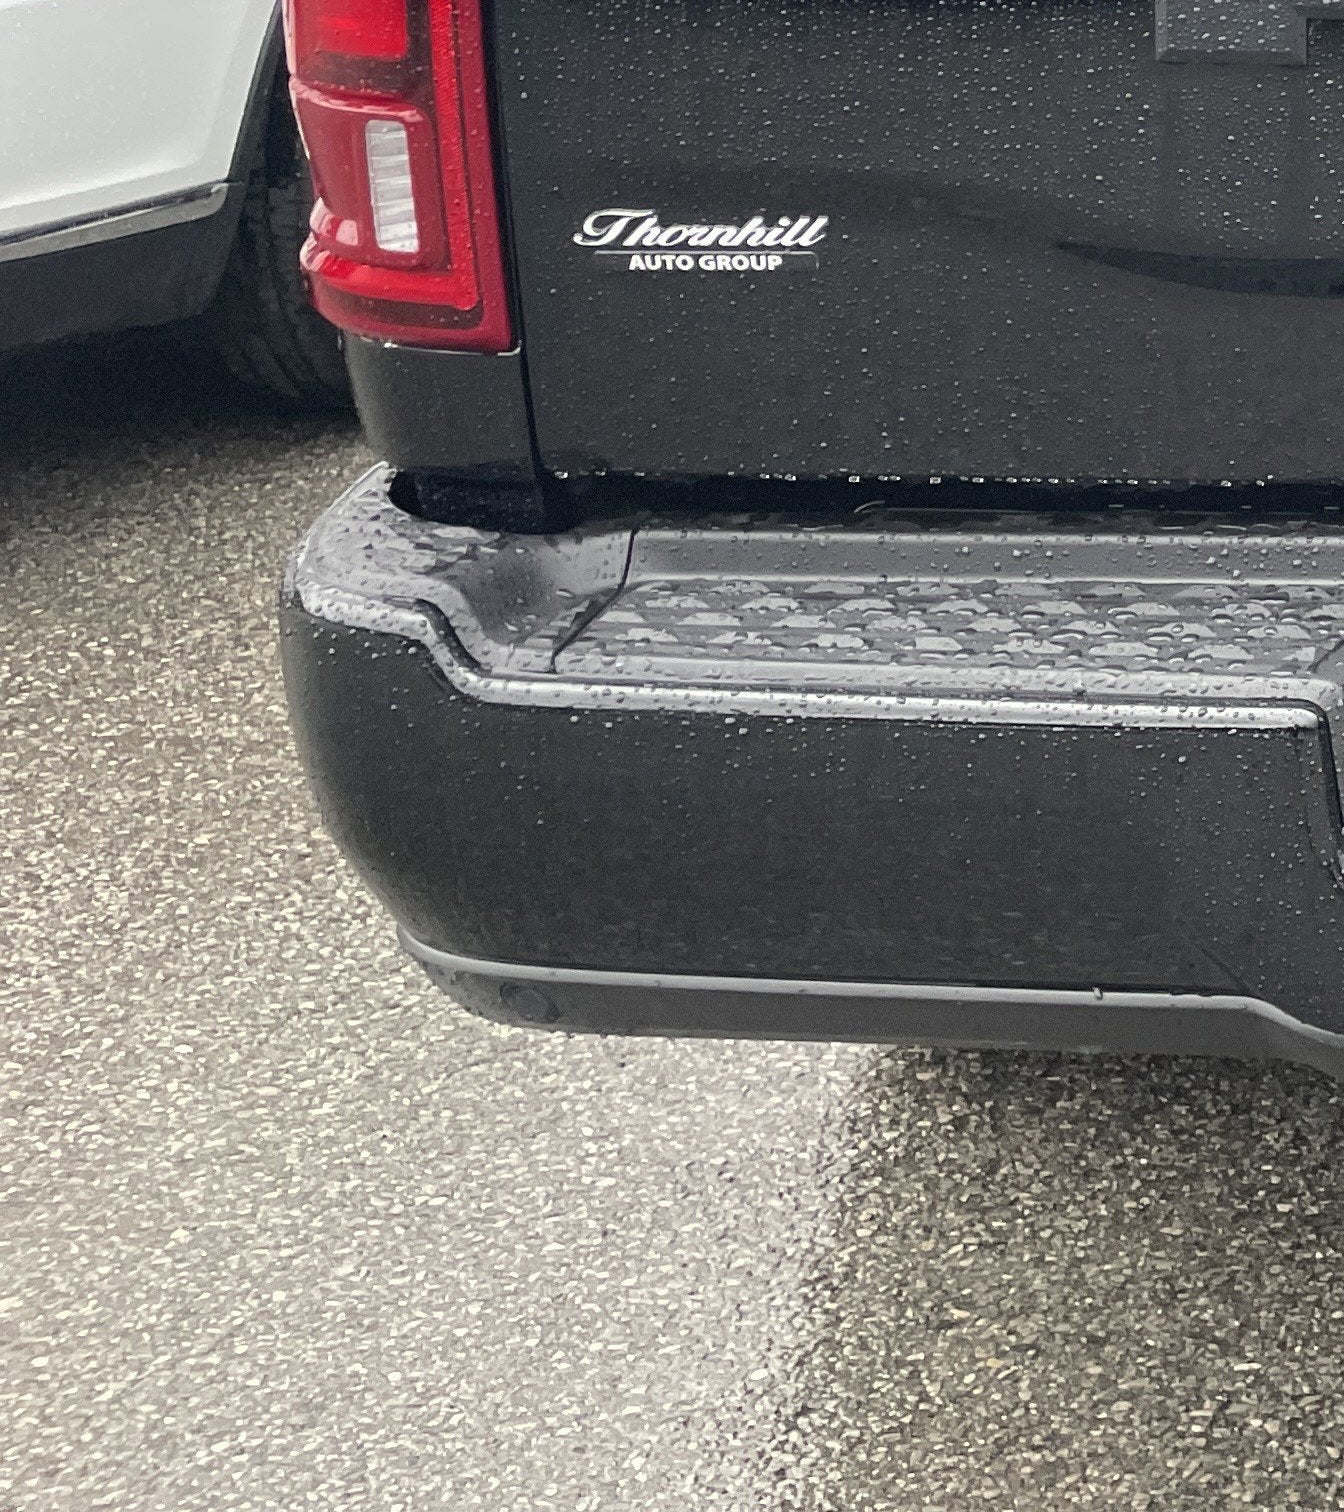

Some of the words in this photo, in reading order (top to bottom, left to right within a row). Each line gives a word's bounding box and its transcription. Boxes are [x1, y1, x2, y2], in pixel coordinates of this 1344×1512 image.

[573, 207, 830, 247] Thornhill
[628, 253, 694, 271] AUTO
[698, 253, 783, 271] GROUP
